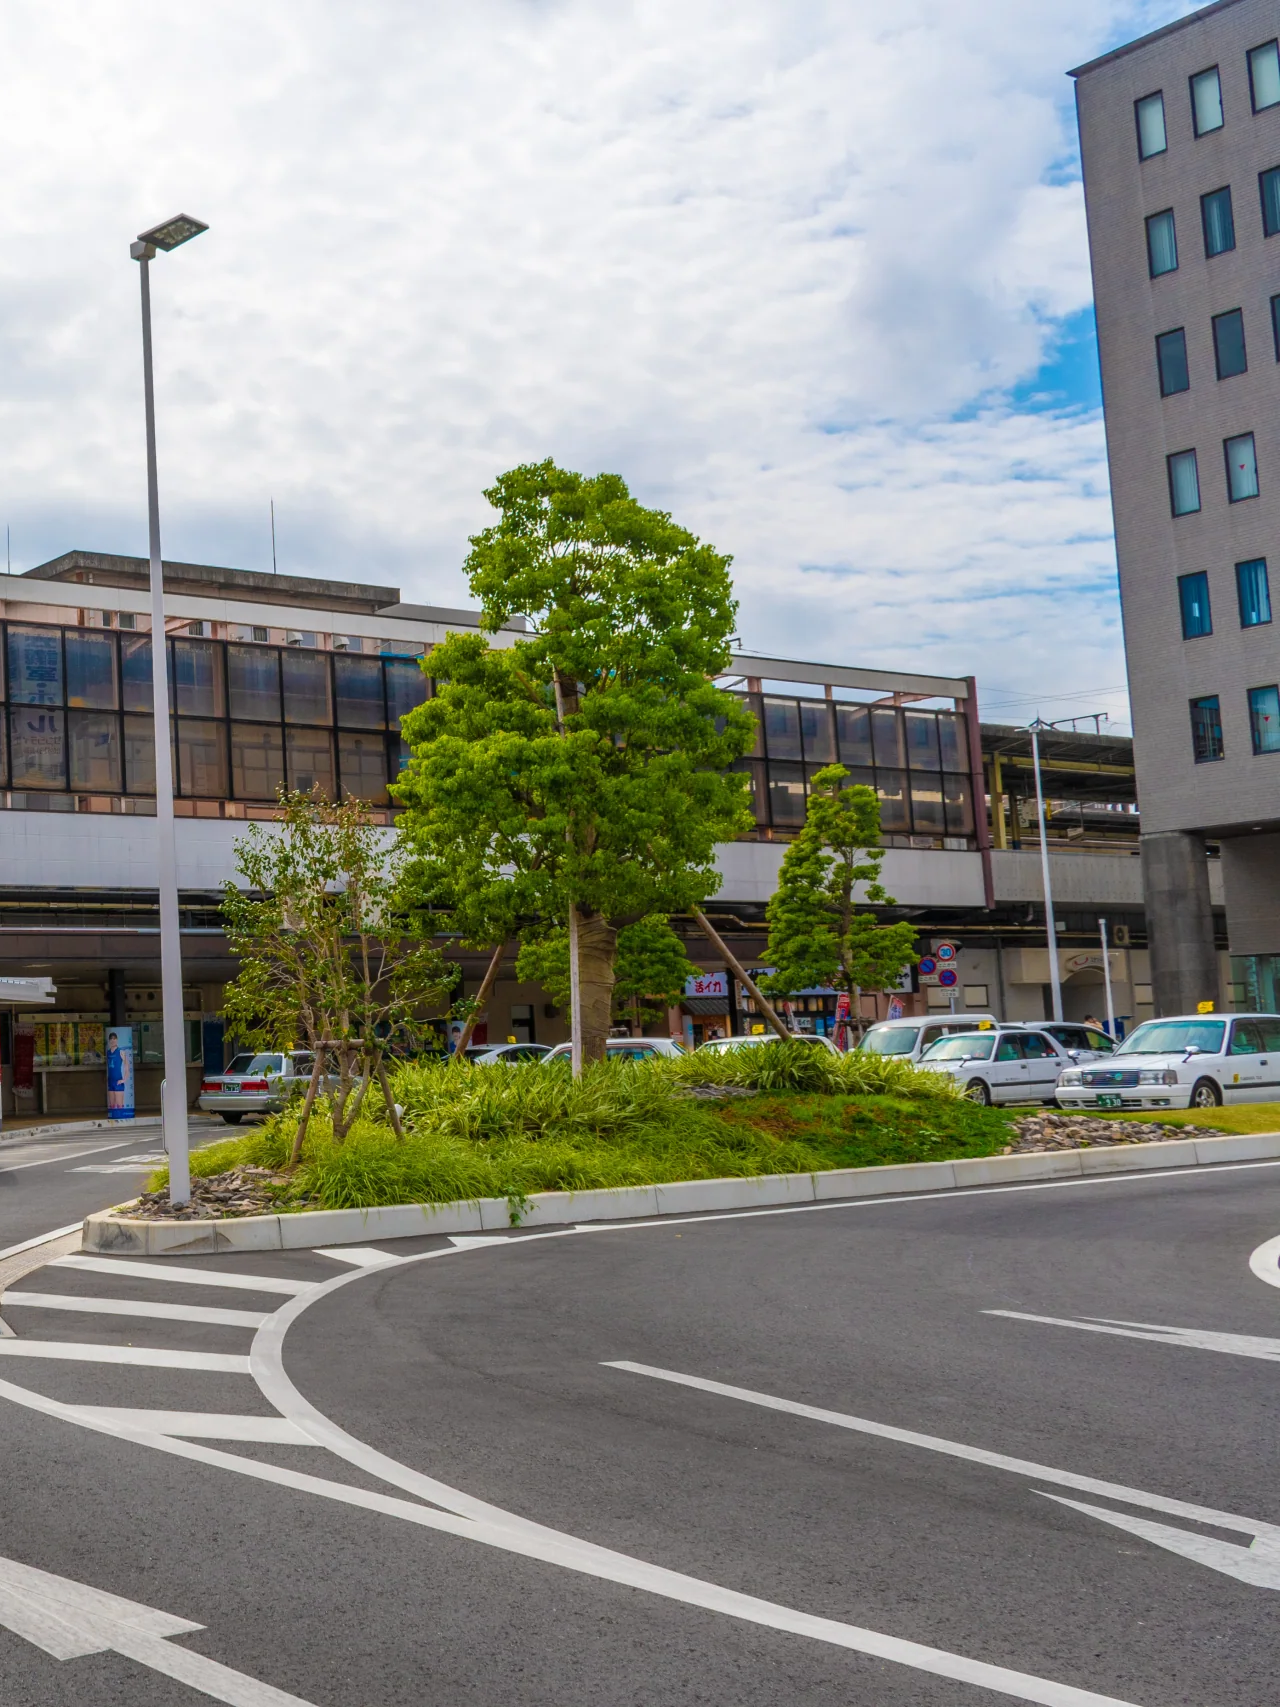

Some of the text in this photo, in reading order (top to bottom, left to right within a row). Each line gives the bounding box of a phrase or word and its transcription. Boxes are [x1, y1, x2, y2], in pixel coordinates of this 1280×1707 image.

[940, 947, 952, 957] 30
[695, 980, 722, 994] 活イカ
